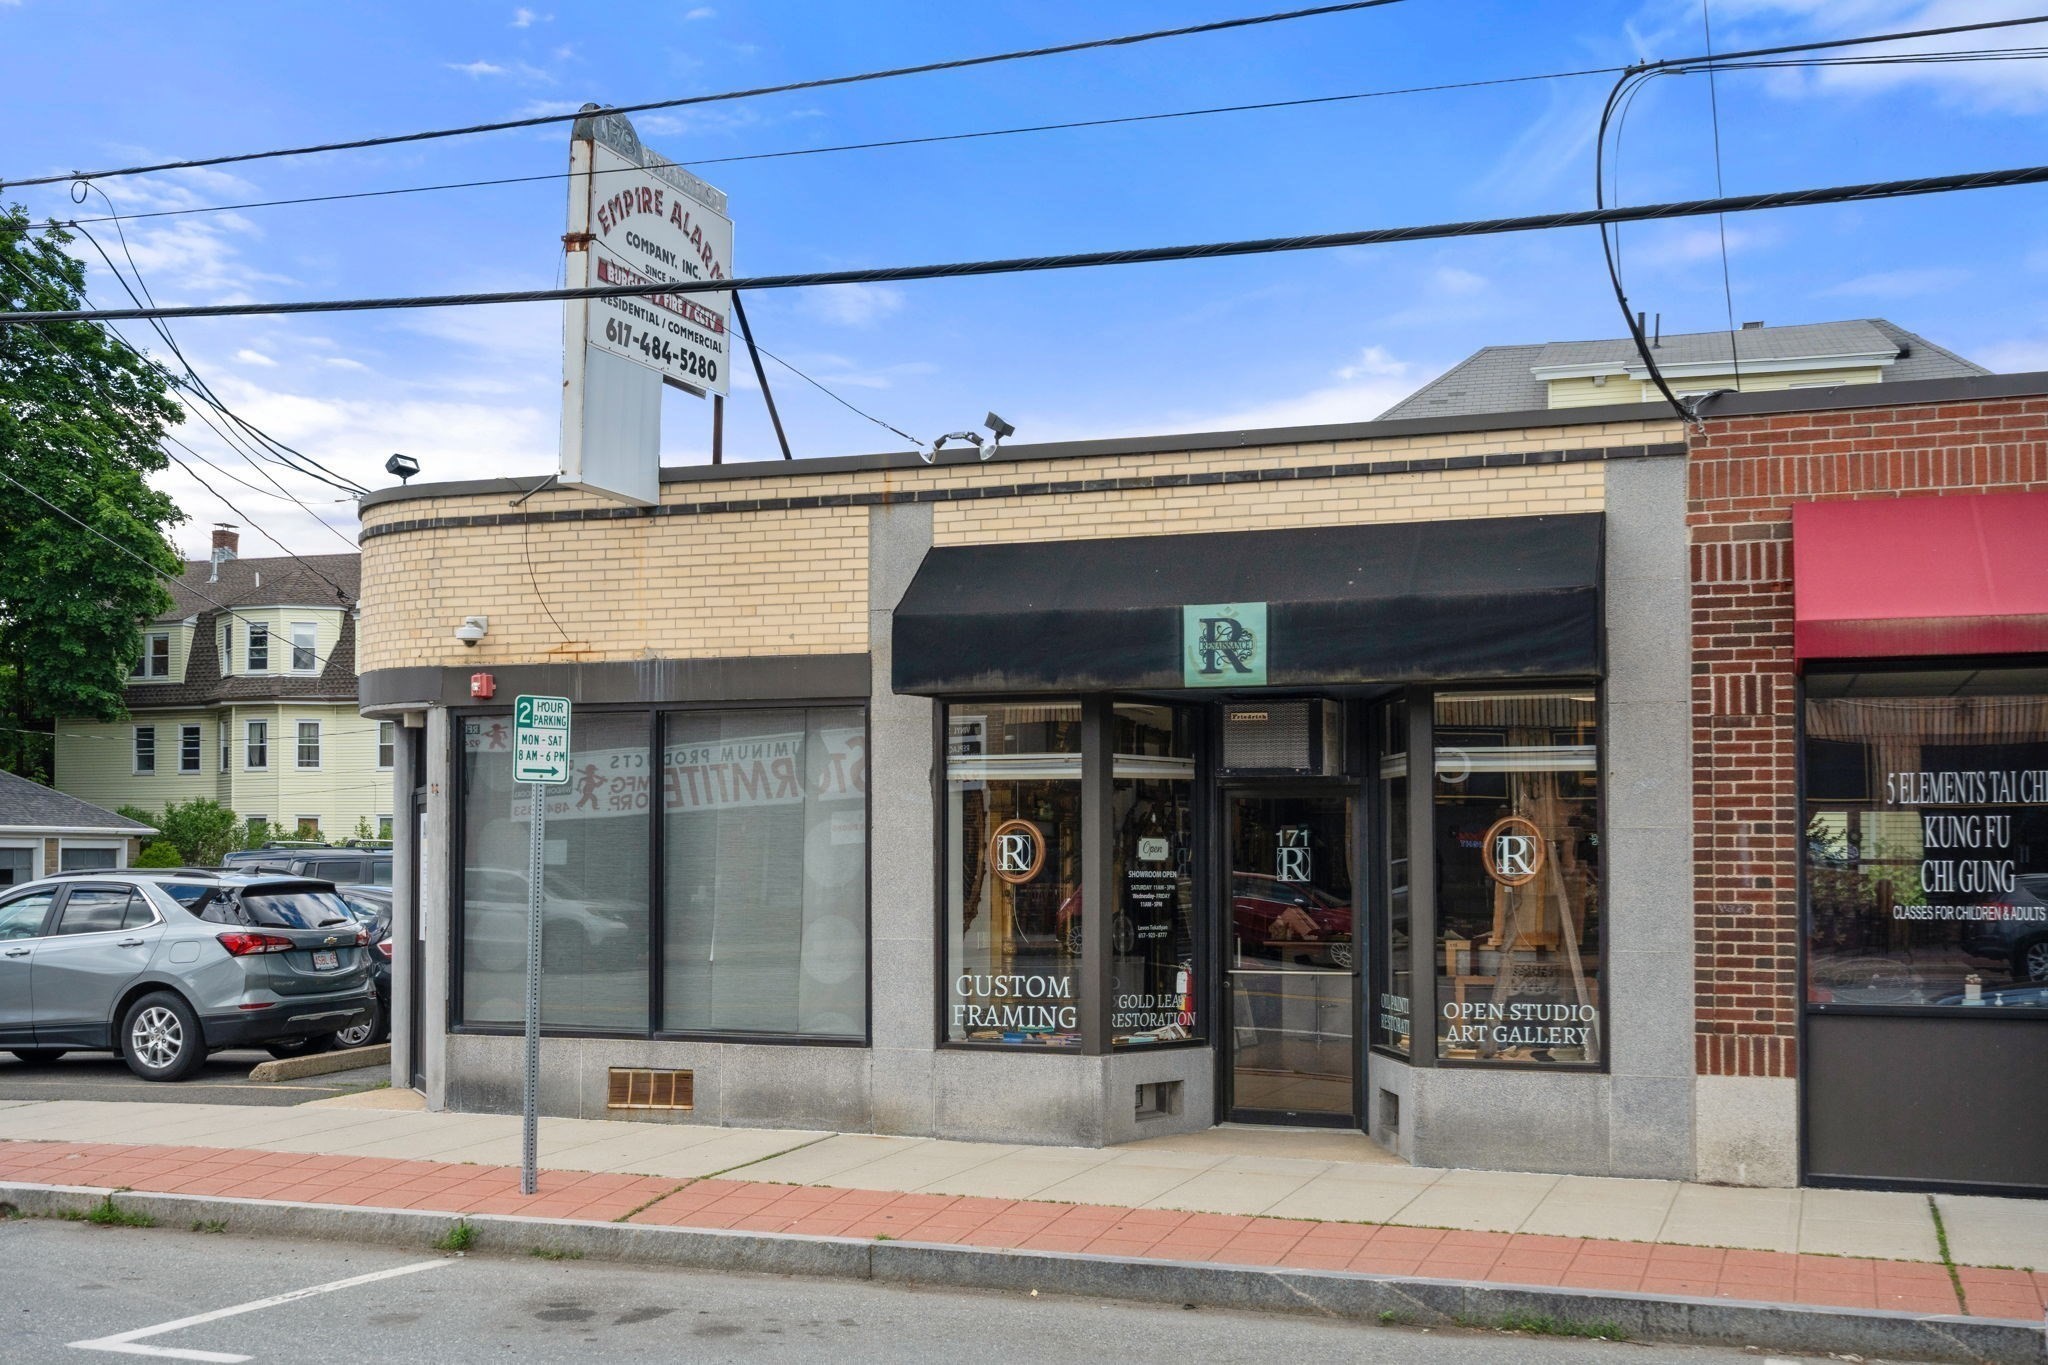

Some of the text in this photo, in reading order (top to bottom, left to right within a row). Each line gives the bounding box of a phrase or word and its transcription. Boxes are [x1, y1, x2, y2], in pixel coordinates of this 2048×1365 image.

[597, 186, 664, 237] EMPIRE
[645, 264, 667, 282] SINCE
[682, 259, 702, 280] INC.
[600, 296, 660, 327] RESIDENTIAL
[668, 320, 723, 353] COMMERCIAL
[606, 317, 718, 382] 617-484-5280
[519, 702, 564, 724] 2 HOUR
[534, 715, 567, 727] PARKING
[522, 734, 539, 745] MON
[548, 735, 562, 747] SAT
[518, 750, 524, 761] 8
[525, 750, 538, 761] AM
[546, 751, 551, 762] 6
[554, 751, 565, 762] PM
[1887, 773, 1895, 804] 5
[1899, 771, 1987, 804] ELEMENTS
[1989, 771, 2018, 803] TAI
[1275, 829, 1308, 847] 171
[1924, 815, 2012, 849] KUNG FU
[997, 835, 1031, 870] R
[1143, 841, 1163, 856] Open
[1496, 836, 1536, 874] R
[1277, 847, 1310, 881] R
[1921, 859, 2017, 893] CHI GUNG
[1893, 905, 2047, 921] CLASSES FOR CHILDREN & ADULTS
[955, 974, 1072, 998] CUSTOM
[1118, 994, 1155, 1009] GOLD
[1443, 1002, 1596, 1022] OPEN STUDIO
[952, 1004, 1077, 1029] FRAMING
[1112, 1012, 1197, 1028] RESTORATION
[1446, 1025, 1591, 1045] ART GALLERY
